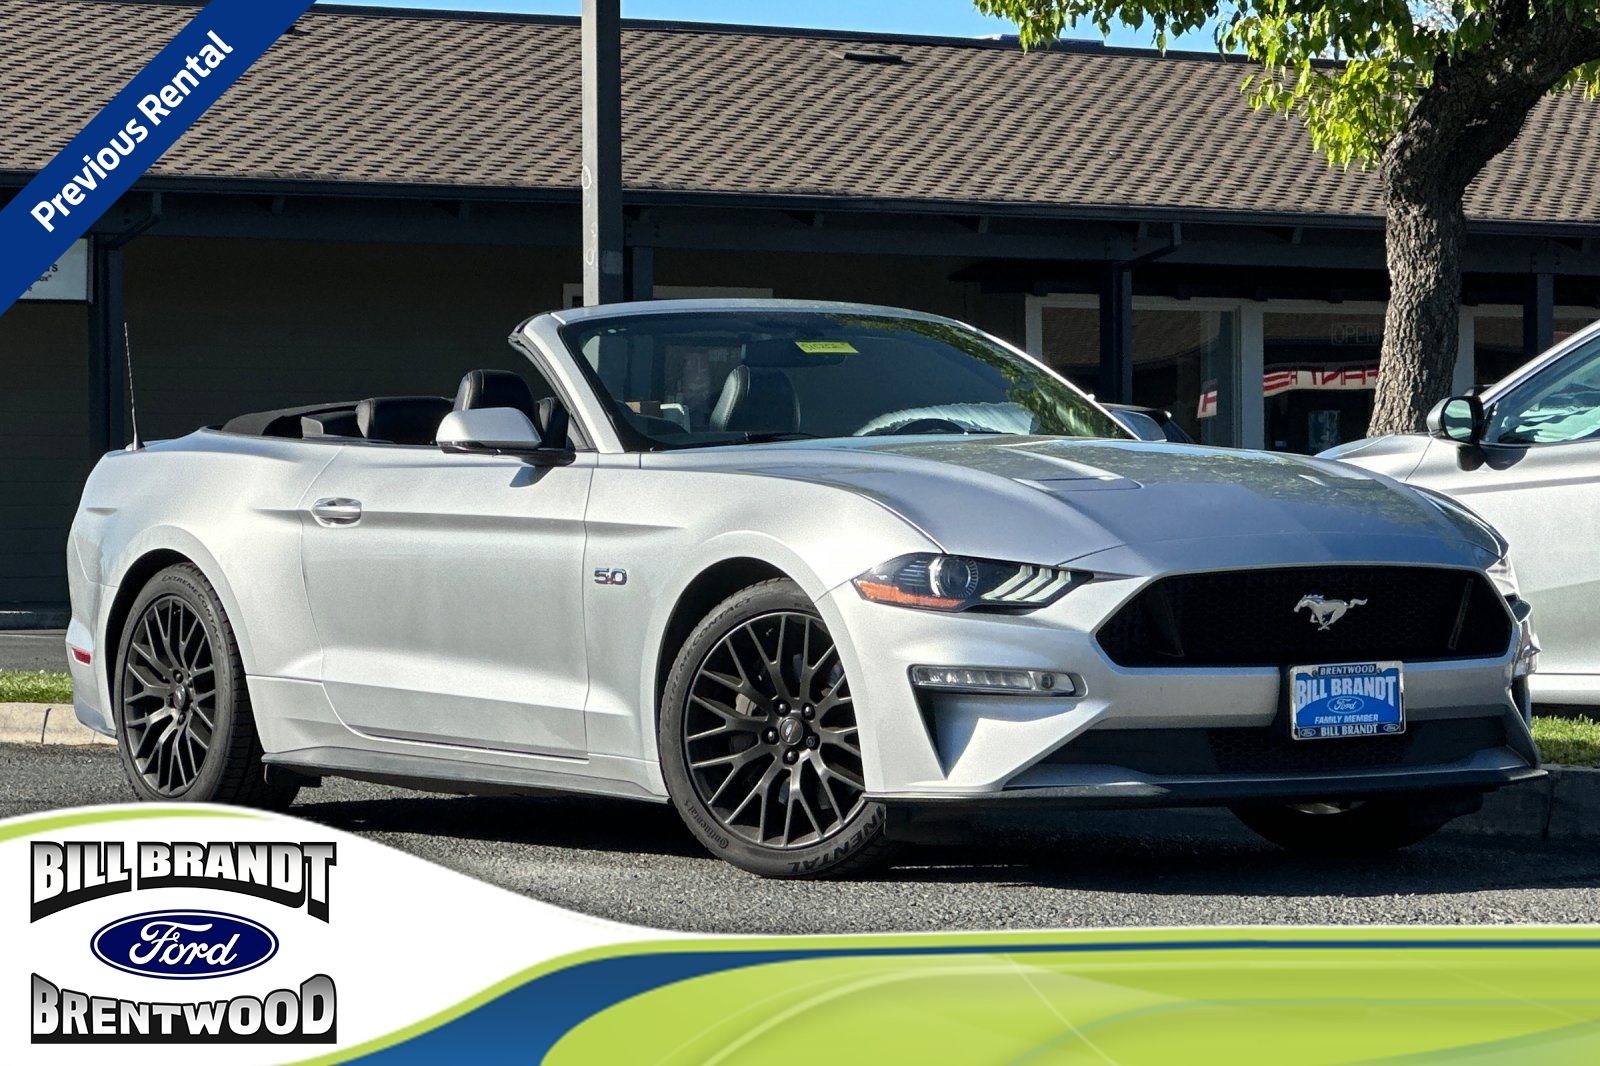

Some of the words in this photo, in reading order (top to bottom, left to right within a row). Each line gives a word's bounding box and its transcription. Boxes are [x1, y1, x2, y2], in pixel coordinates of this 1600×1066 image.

[594, 568, 627, 586] 5.0
[1320, 664, 1375, 676] BRENTWOOD
[1296, 679, 1328, 713] BILL
[1331, 676, 1397, 707] BRANDT
[1333, 698, 1357, 711] Ford
[1314, 715, 1343, 724] FAMILY
[1344, 714, 1379, 723] MEMBER
[1320, 726, 1339, 737] BILL
[1341, 723, 1378, 736] BRANDT
[688, 805, 729, 849] Continental
